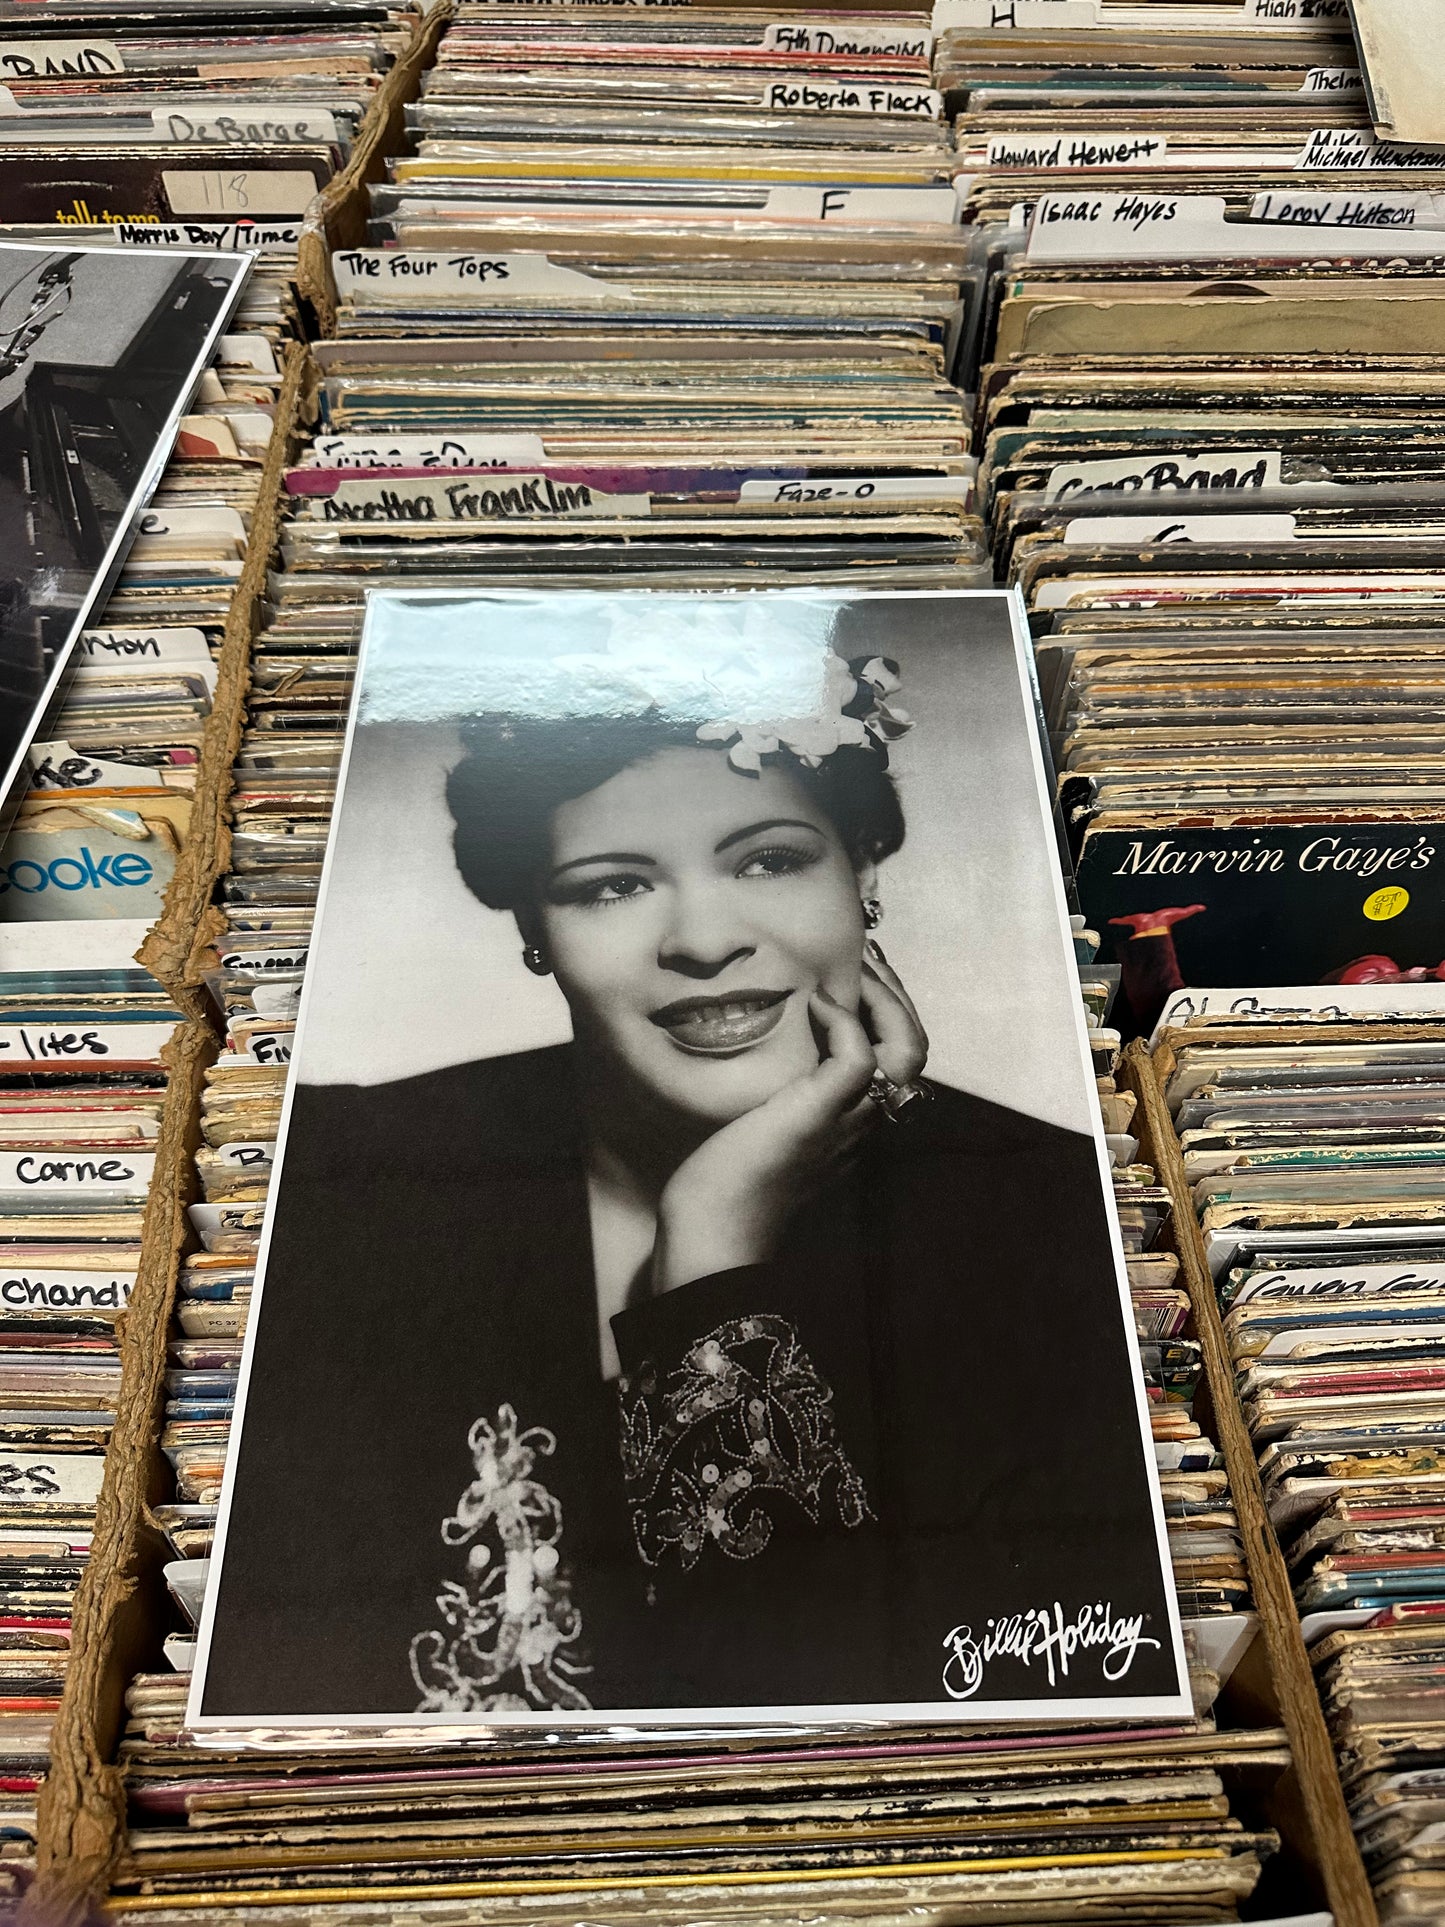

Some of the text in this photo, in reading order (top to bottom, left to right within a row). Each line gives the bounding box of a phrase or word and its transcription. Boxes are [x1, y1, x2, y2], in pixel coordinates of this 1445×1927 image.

[770, 84, 860, 109] Roberta
[1302, 146, 1370, 168] Michael
[821, 190, 851, 219] F
[1040, 199, 1102, 225] Isaac
[1112, 196, 1177, 232] Hayes
[119, 224, 180, 244] Morris
[339, 252, 510, 282] The Four Tops
[0, 847, 153, 894] ooke
[1112, 836, 1436, 877] Marvin Gaye's
[16, 1156, 136, 1184] Carne
[943, 1601, 1162, 1699] Billie Holiday
